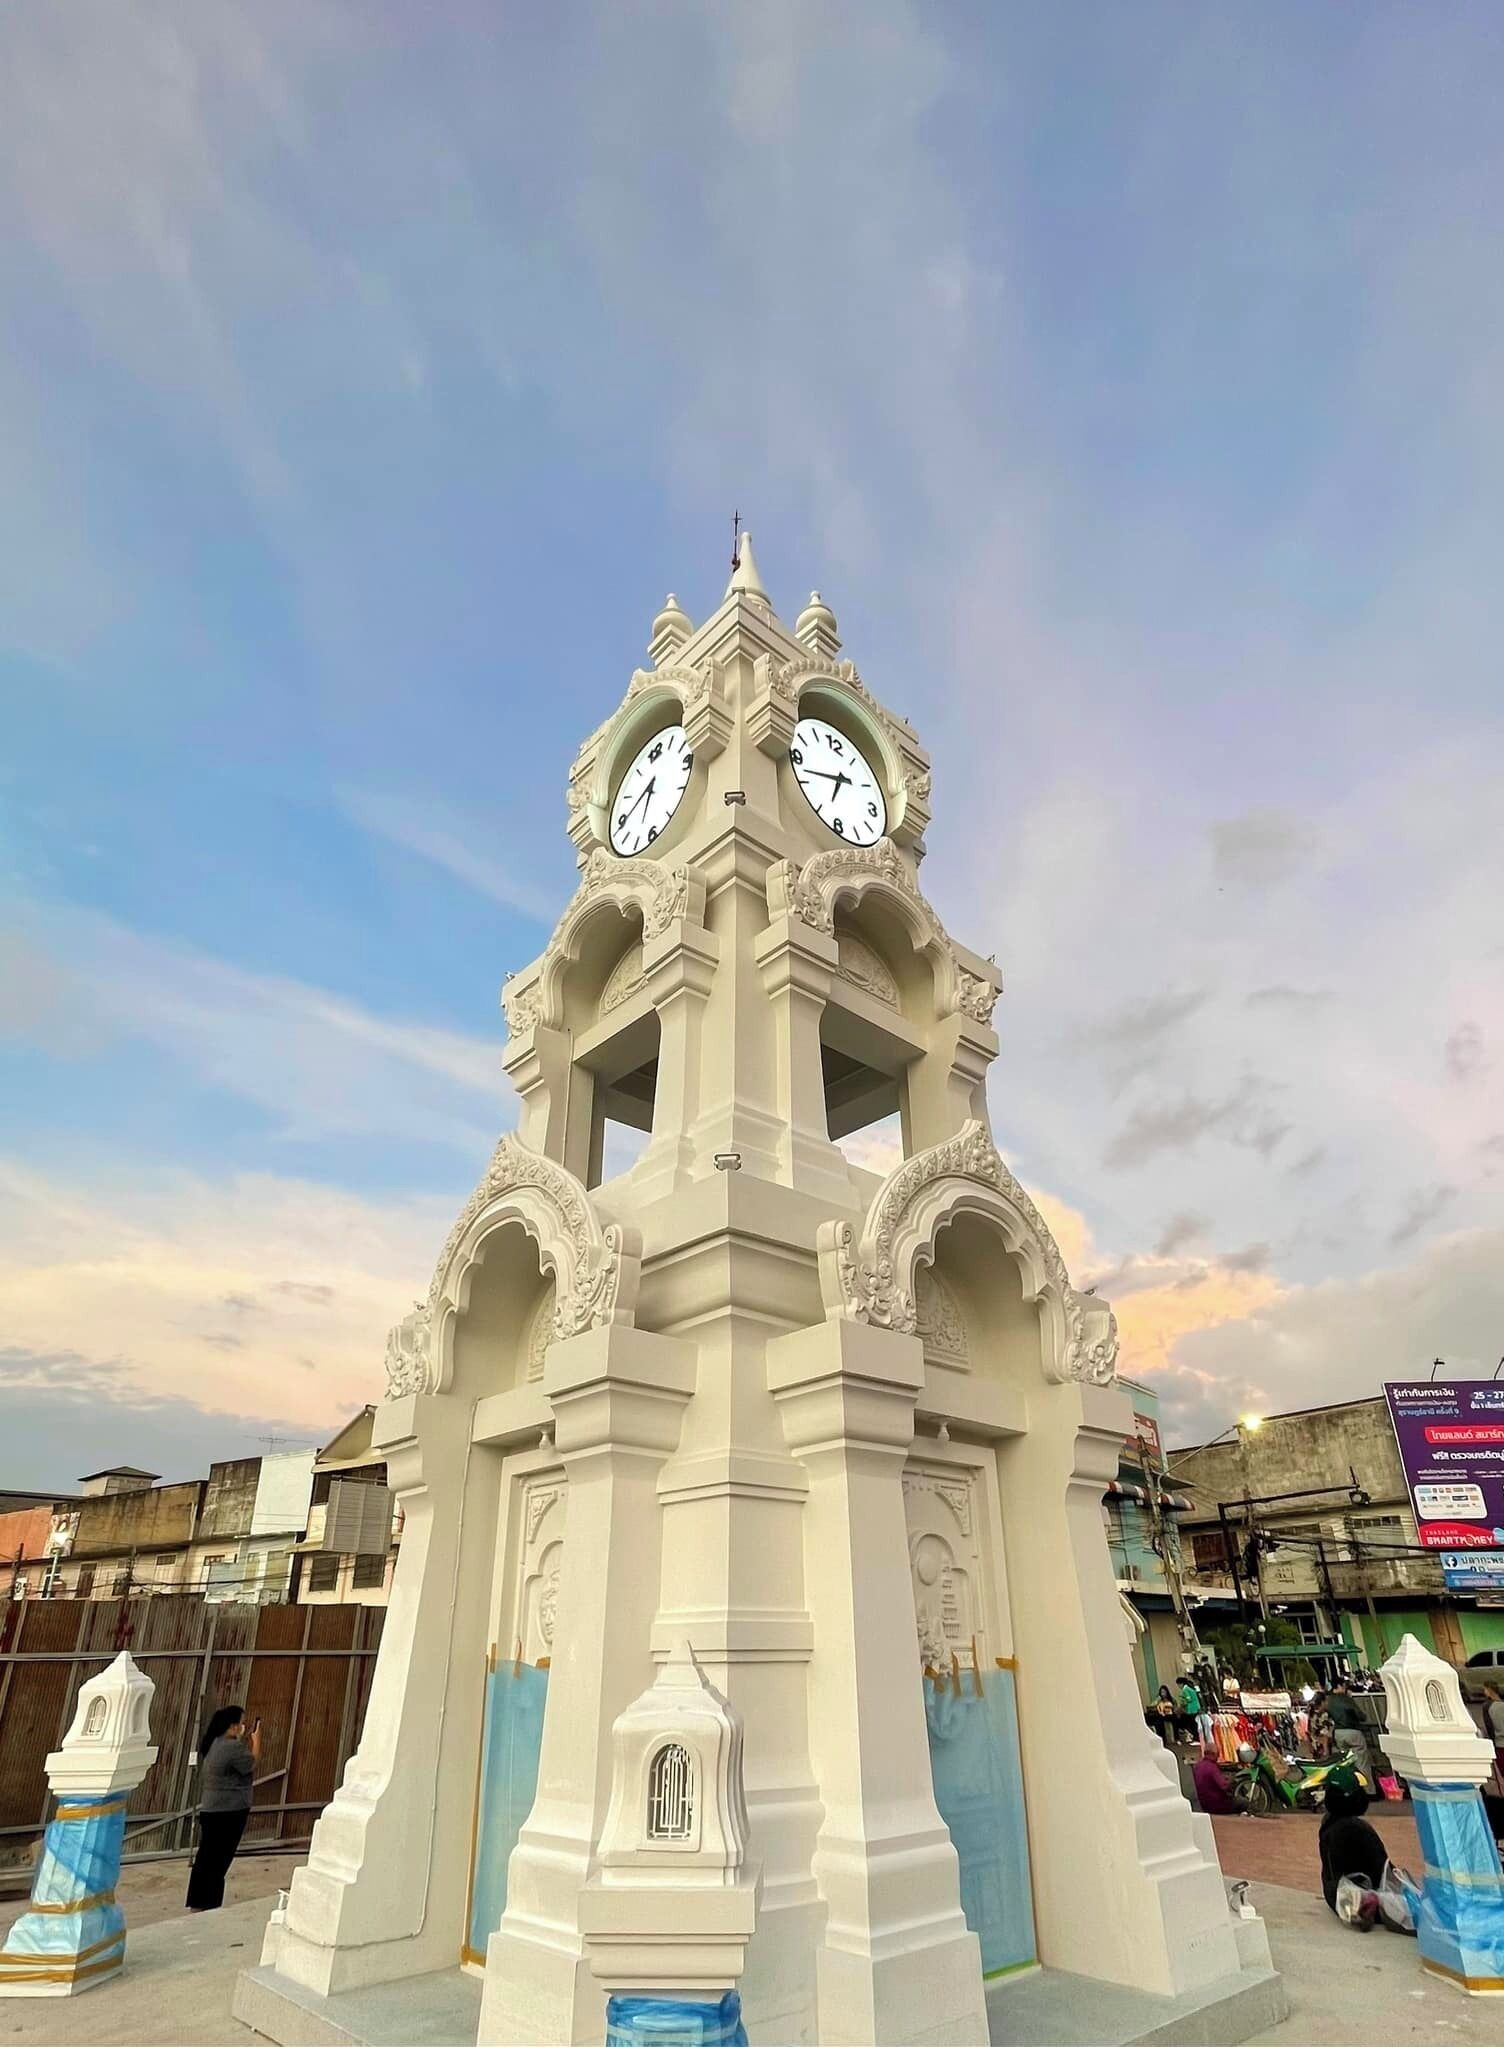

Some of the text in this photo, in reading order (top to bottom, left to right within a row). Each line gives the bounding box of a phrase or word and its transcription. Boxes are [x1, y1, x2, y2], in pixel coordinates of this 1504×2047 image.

[826, 734, 844, 758] 12
[868, 802, 878, 818] 3
[1473, 1391, 1485, 1400] 25
